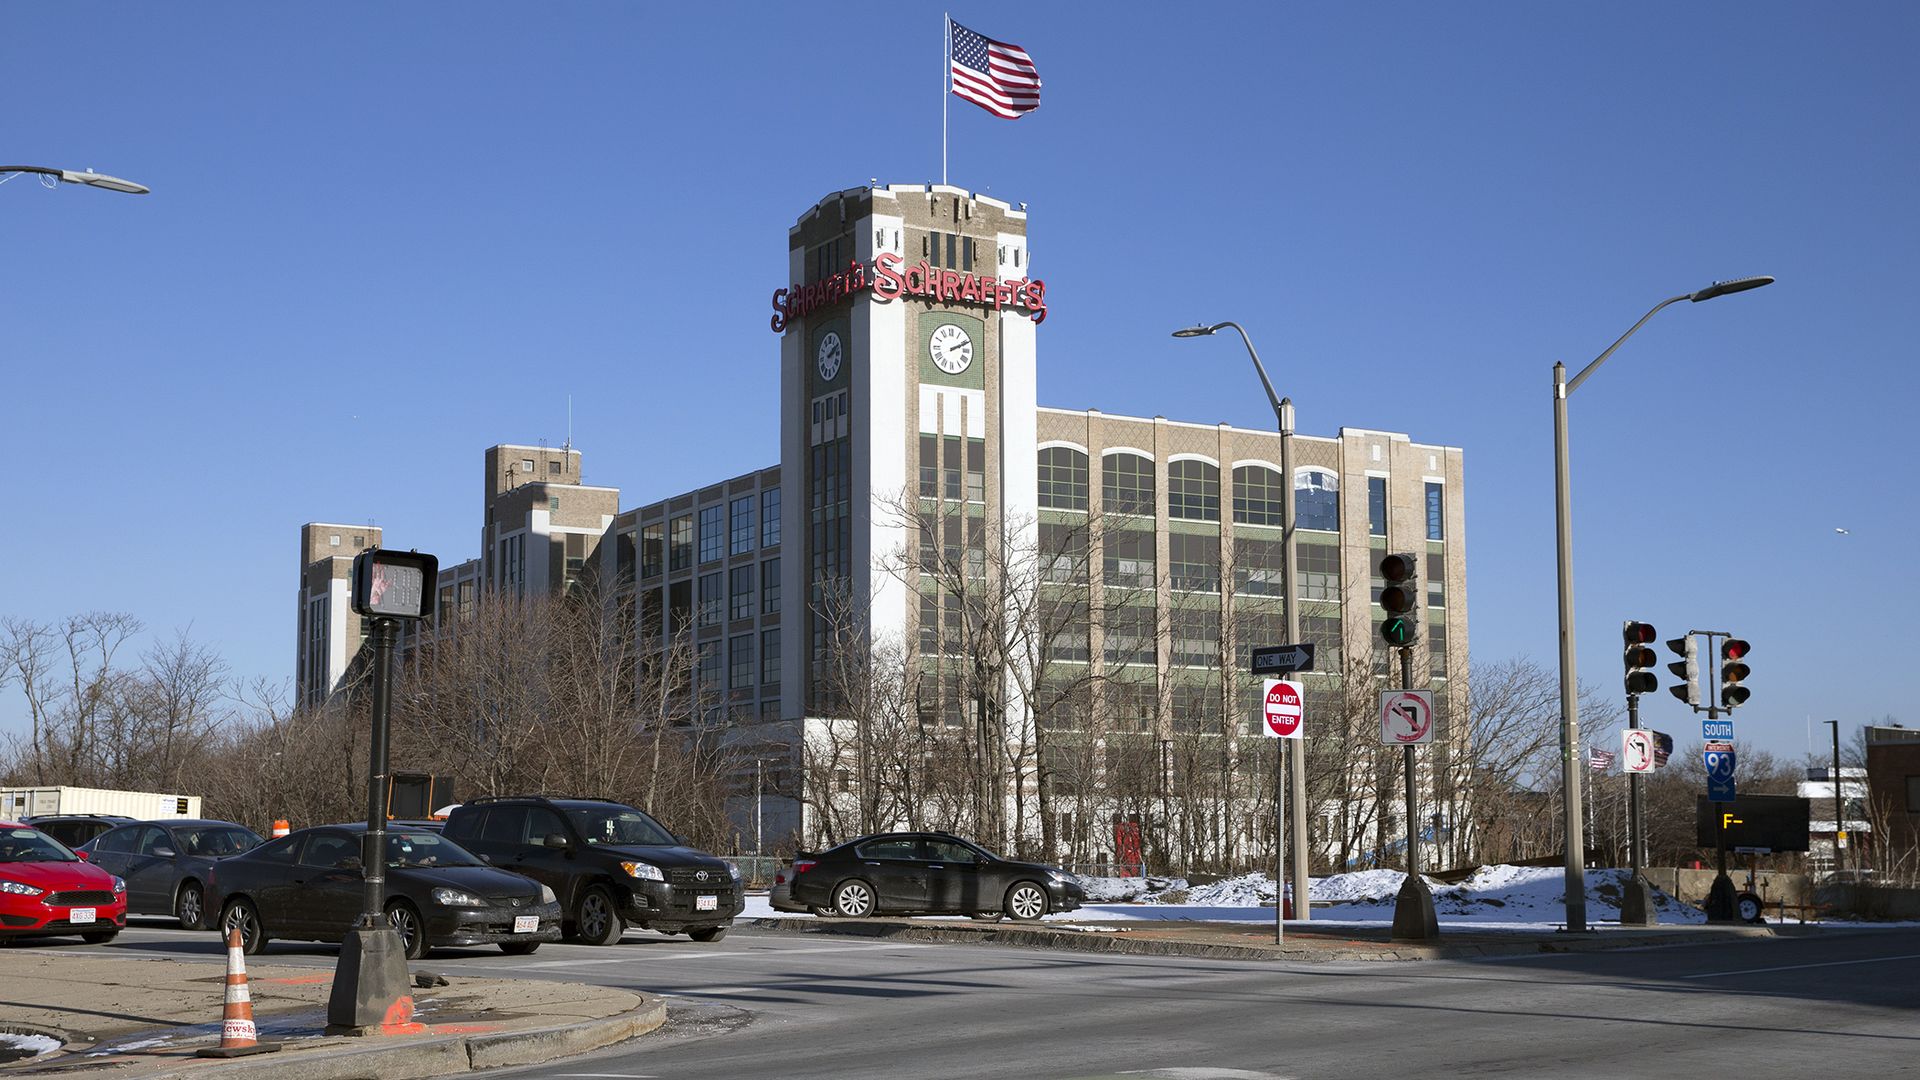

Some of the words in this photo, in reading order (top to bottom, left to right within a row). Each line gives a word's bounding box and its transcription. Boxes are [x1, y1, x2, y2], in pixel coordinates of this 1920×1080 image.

[872, 252, 1047, 325] SCHRAFFT'S
[1257, 655, 1273, 667] ONE
[1279, 653, 1297, 665] WAY
[1269, 693, 1280, 703] DO
[1282, 694, 1297, 704] NOT
[1271, 715, 1295, 725] ENTER
[1704, 723, 1732, 736] SOUTH
[1707, 753, 1731, 776] 93
